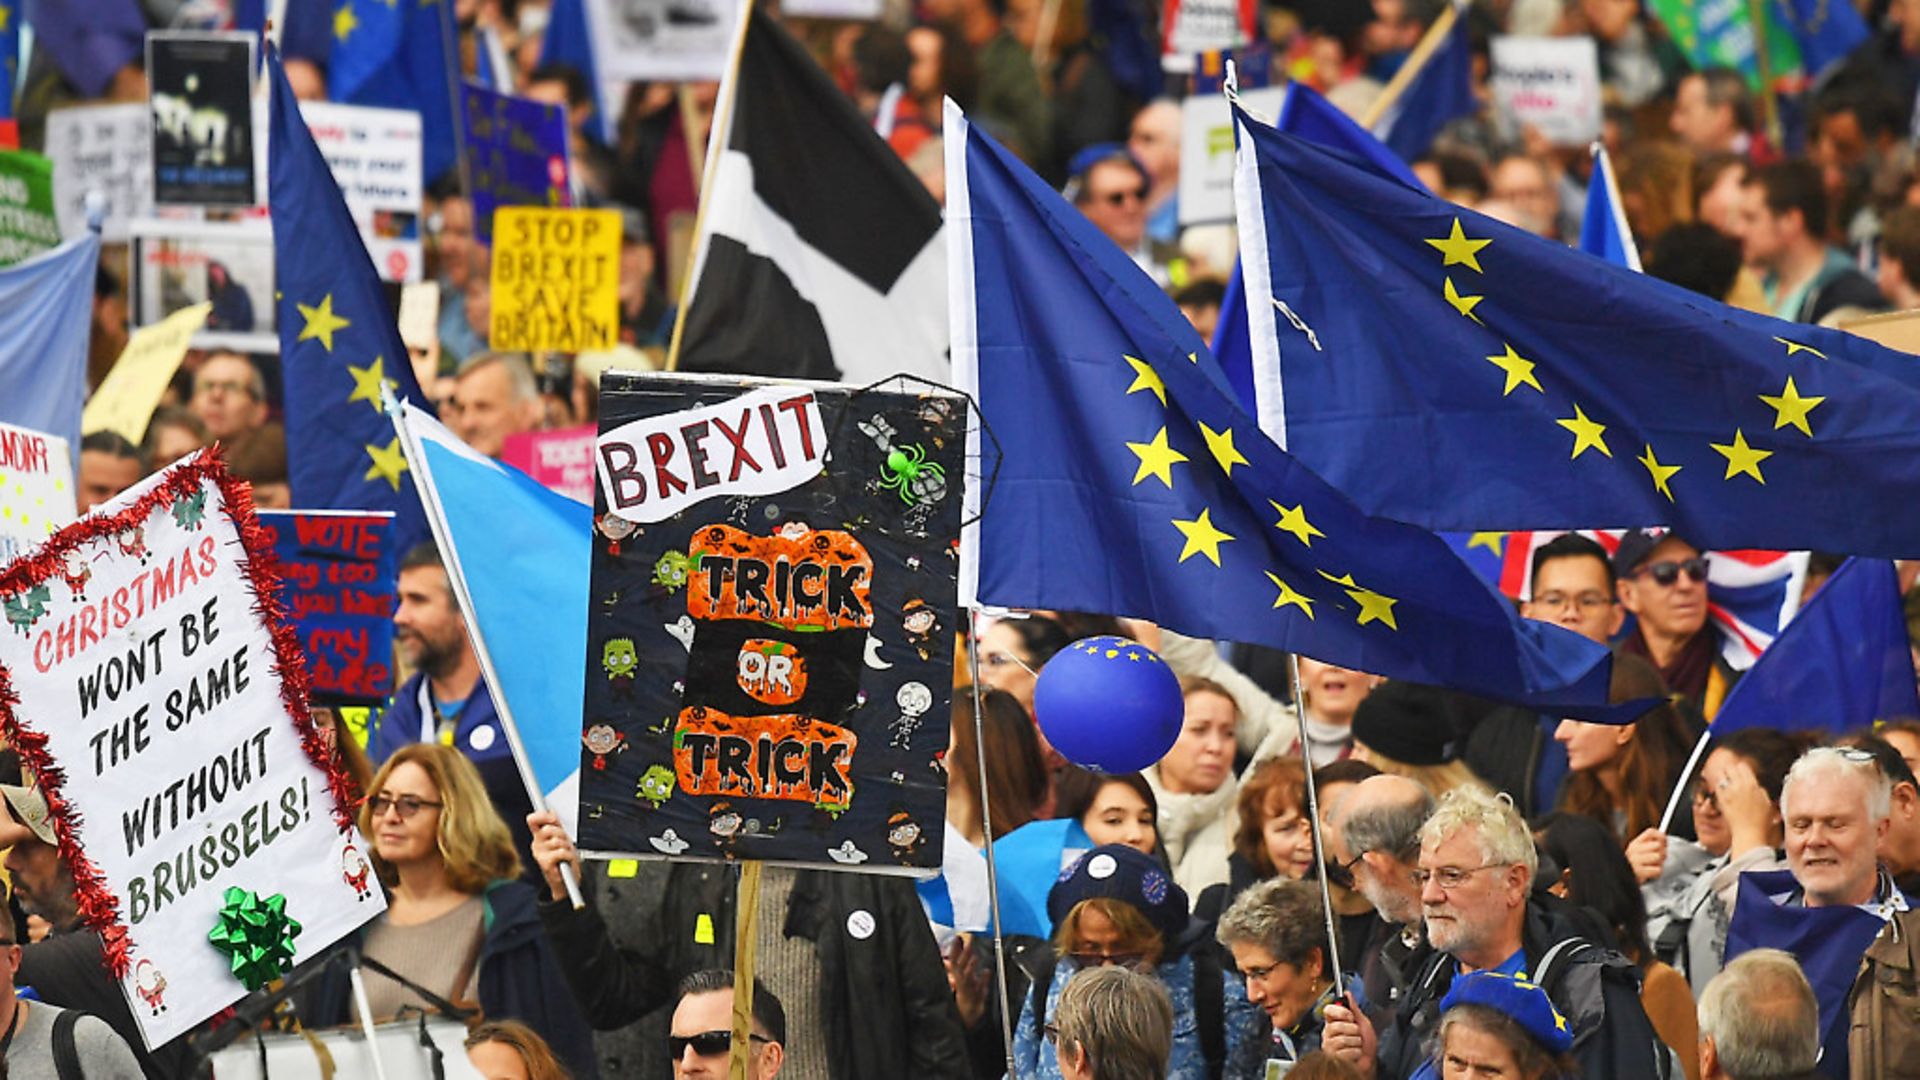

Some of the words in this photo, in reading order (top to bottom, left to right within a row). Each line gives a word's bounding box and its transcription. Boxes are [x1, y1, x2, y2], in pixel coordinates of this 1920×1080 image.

[512, 217, 601, 248] STOP
[497, 248, 607, 286] BREXIT
[512, 281, 597, 322] SAVE
[494, 313, 608, 350] BRITAIN
[600, 393, 816, 509] BREXIT
[294, 514, 390, 560] VOTE
[327, 562, 378, 585] too
[699, 555, 867, 628] TRICK
[33, 536, 219, 674] CHRISTMAS
[291, 592, 336, 619] you
[78, 628, 167, 720] WONT
[179, 596, 221, 657] BE
[309, 628, 369, 667] my
[739, 652, 794, 697] OR
[89, 702, 152, 777] THE
[165, 644, 251, 732] SAME
[682, 733, 850, 804] TRICK
[122, 727, 272, 857] WITHOUT
[127, 777, 311, 924] BRUSSELS!
